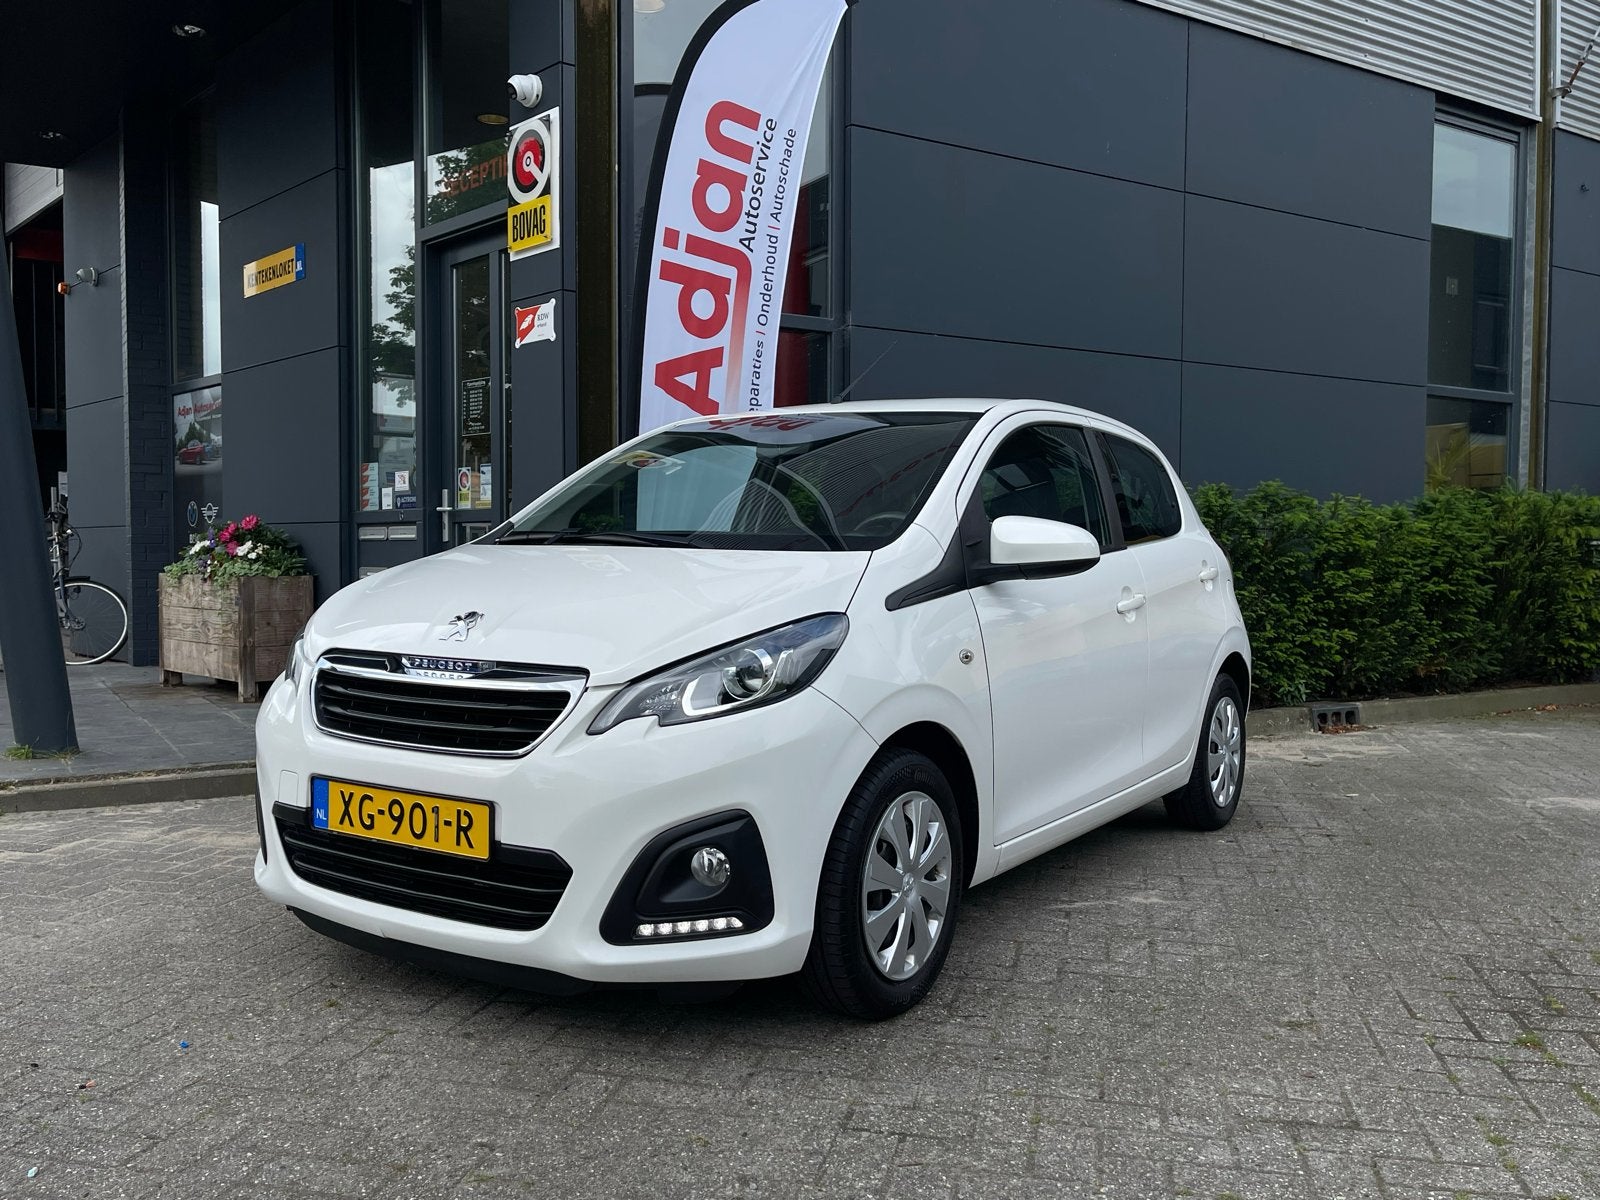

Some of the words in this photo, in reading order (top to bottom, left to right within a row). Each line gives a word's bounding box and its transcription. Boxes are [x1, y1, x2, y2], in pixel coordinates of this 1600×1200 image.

[738, 117, 777, 253] Autoservice
[512, 204, 546, 242] BOVAG
[756, 234, 779, 327] Onderhoud
[769, 128, 797, 223] Autoschade
[654, 99, 762, 416] Adjan
[537, 312, 549, 321] RDW
[177, 405, 192, 419] Adjan
[414, 658, 472, 671] PEUGEOT
[316, 808, 327, 821] NL
[339, 789, 474, 849] XG-901-R
